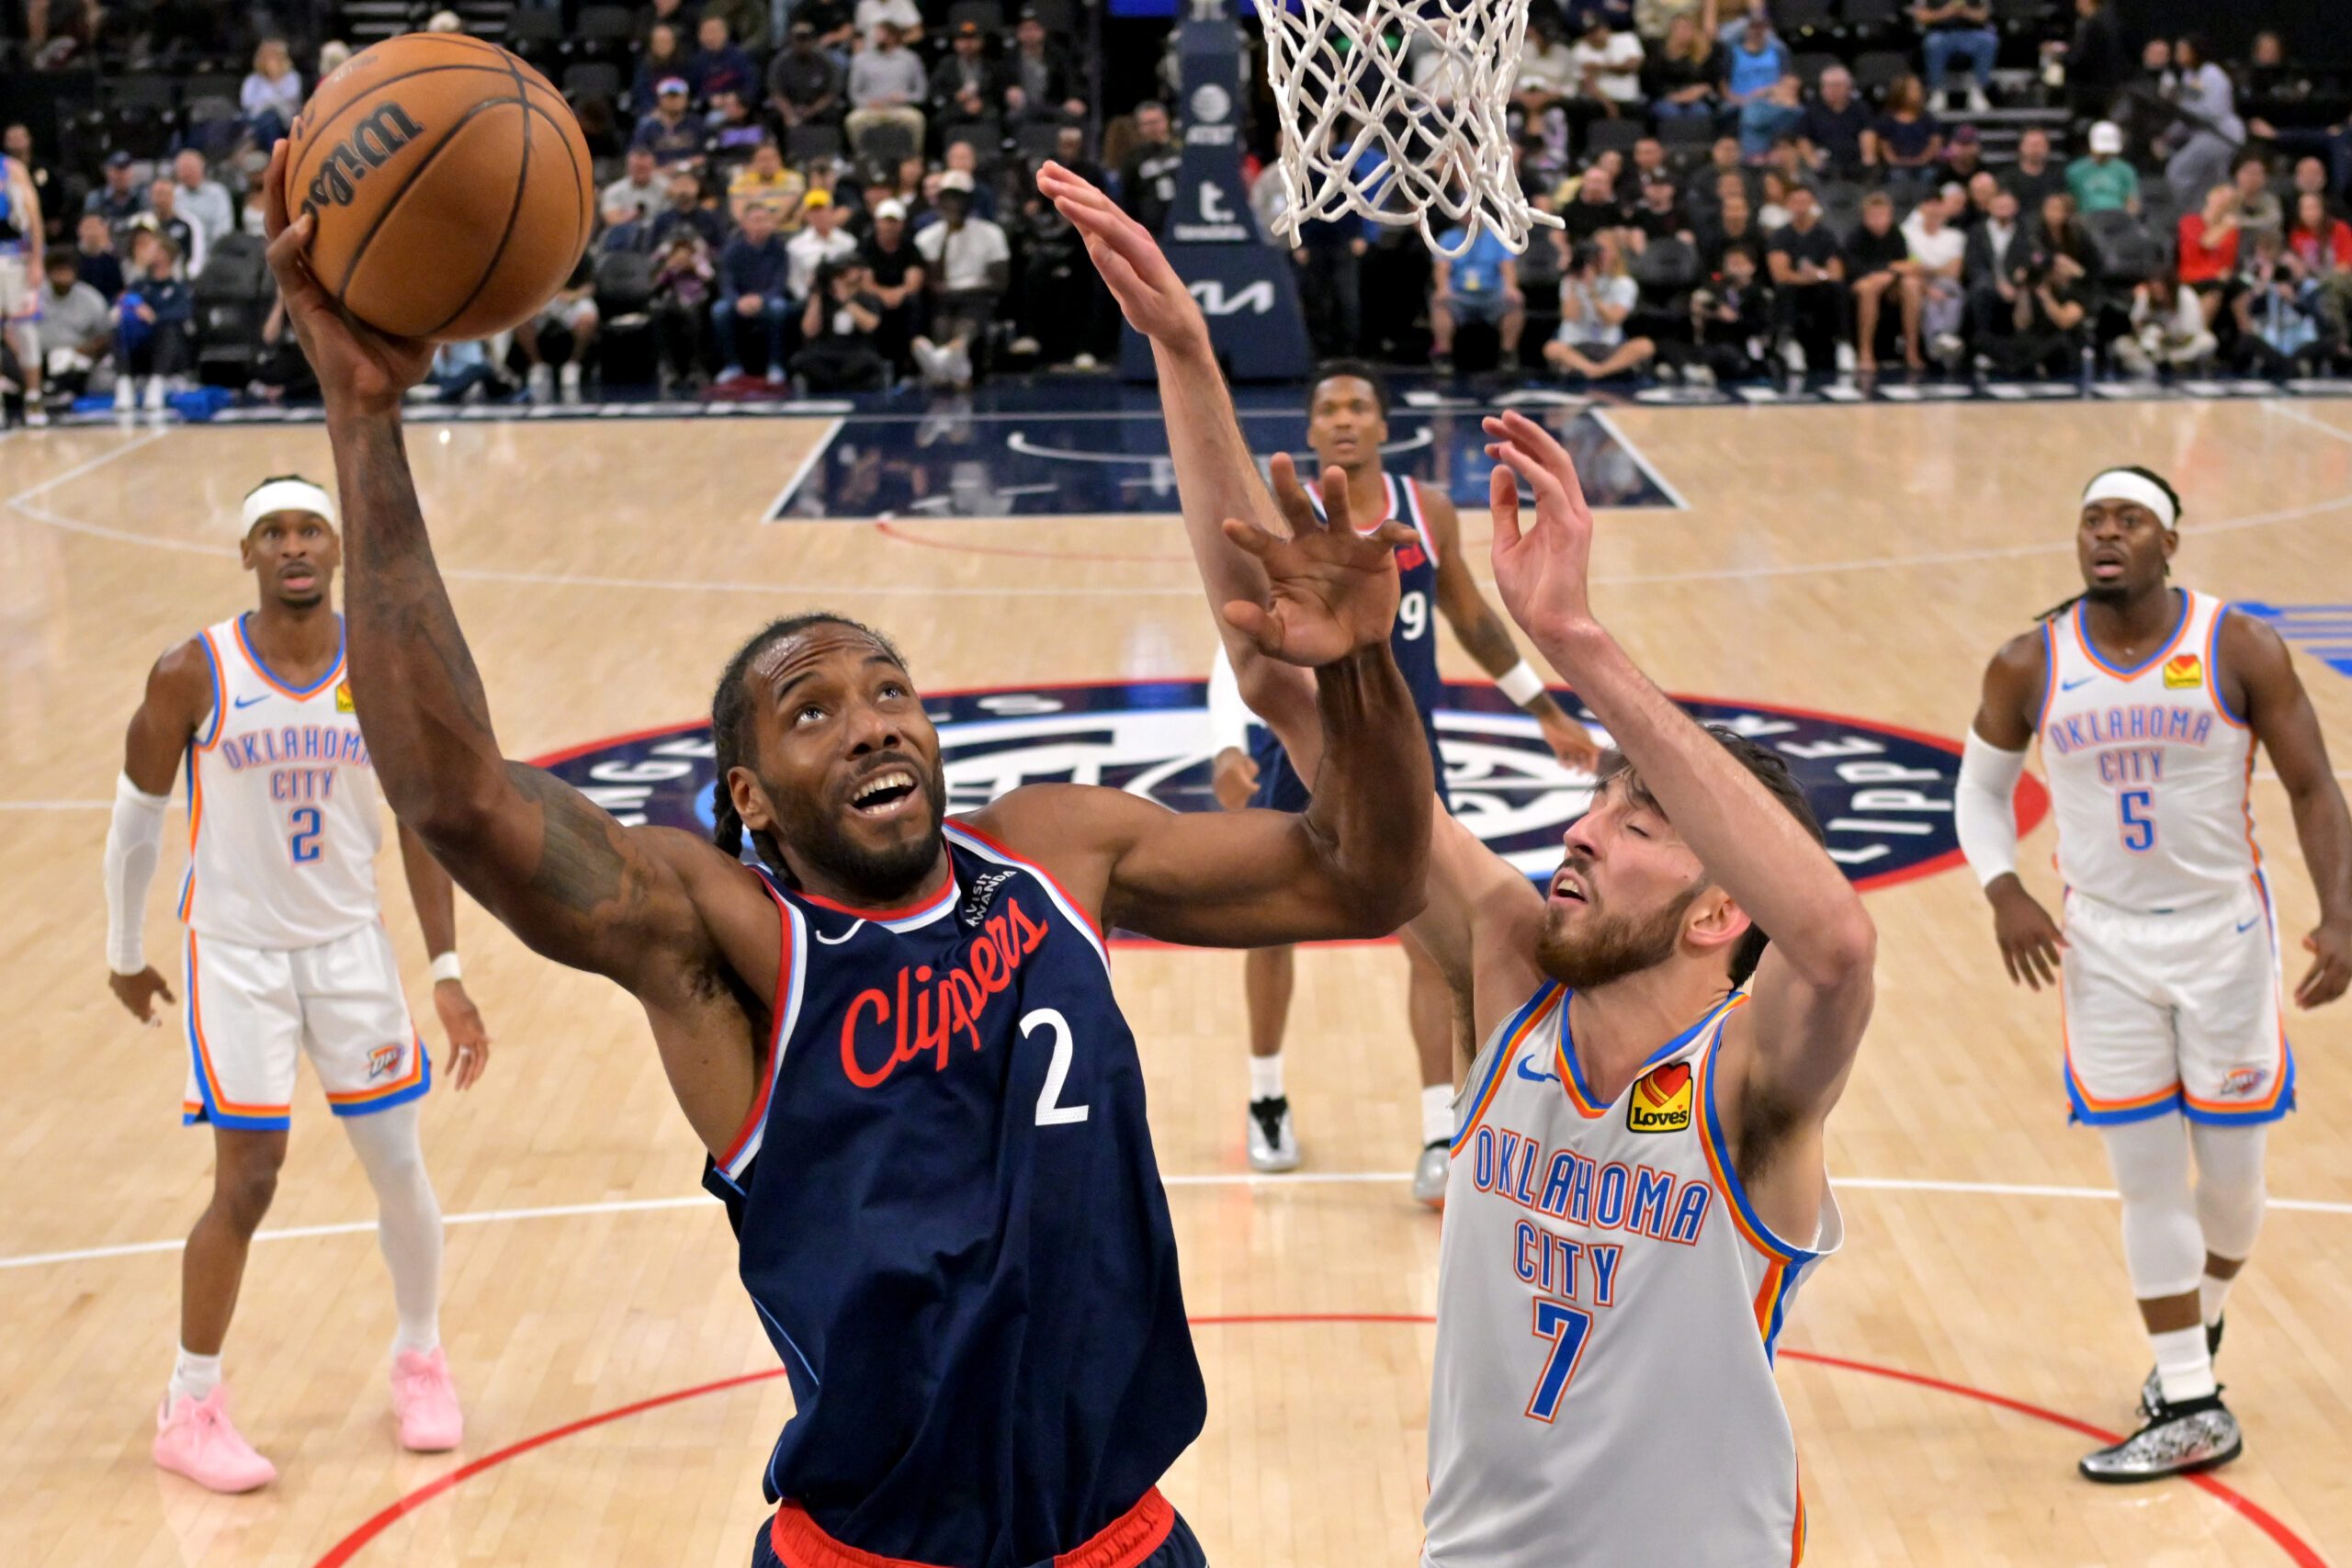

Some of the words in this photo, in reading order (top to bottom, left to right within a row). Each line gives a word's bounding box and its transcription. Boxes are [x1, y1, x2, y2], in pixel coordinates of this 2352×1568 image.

[2049, 706, 2216, 754] OKLAHOMA
[269, 766, 339, 803] CITY
[2098, 747, 2165, 787] CITY
[288, 805, 323, 868] 2
[2117, 786, 2157, 856] 5
[966, 873, 991, 913] VISIT
[966, 870, 1017, 928] RWANDA
[840, 897, 1049, 1089] Clippers
[1019, 1008, 1090, 1126] 2
[1473, 1124, 1713, 1247] OKLAHOMA
[1514, 1219, 1623, 1307] CITY
[1524, 1296, 1594, 1424] 7
